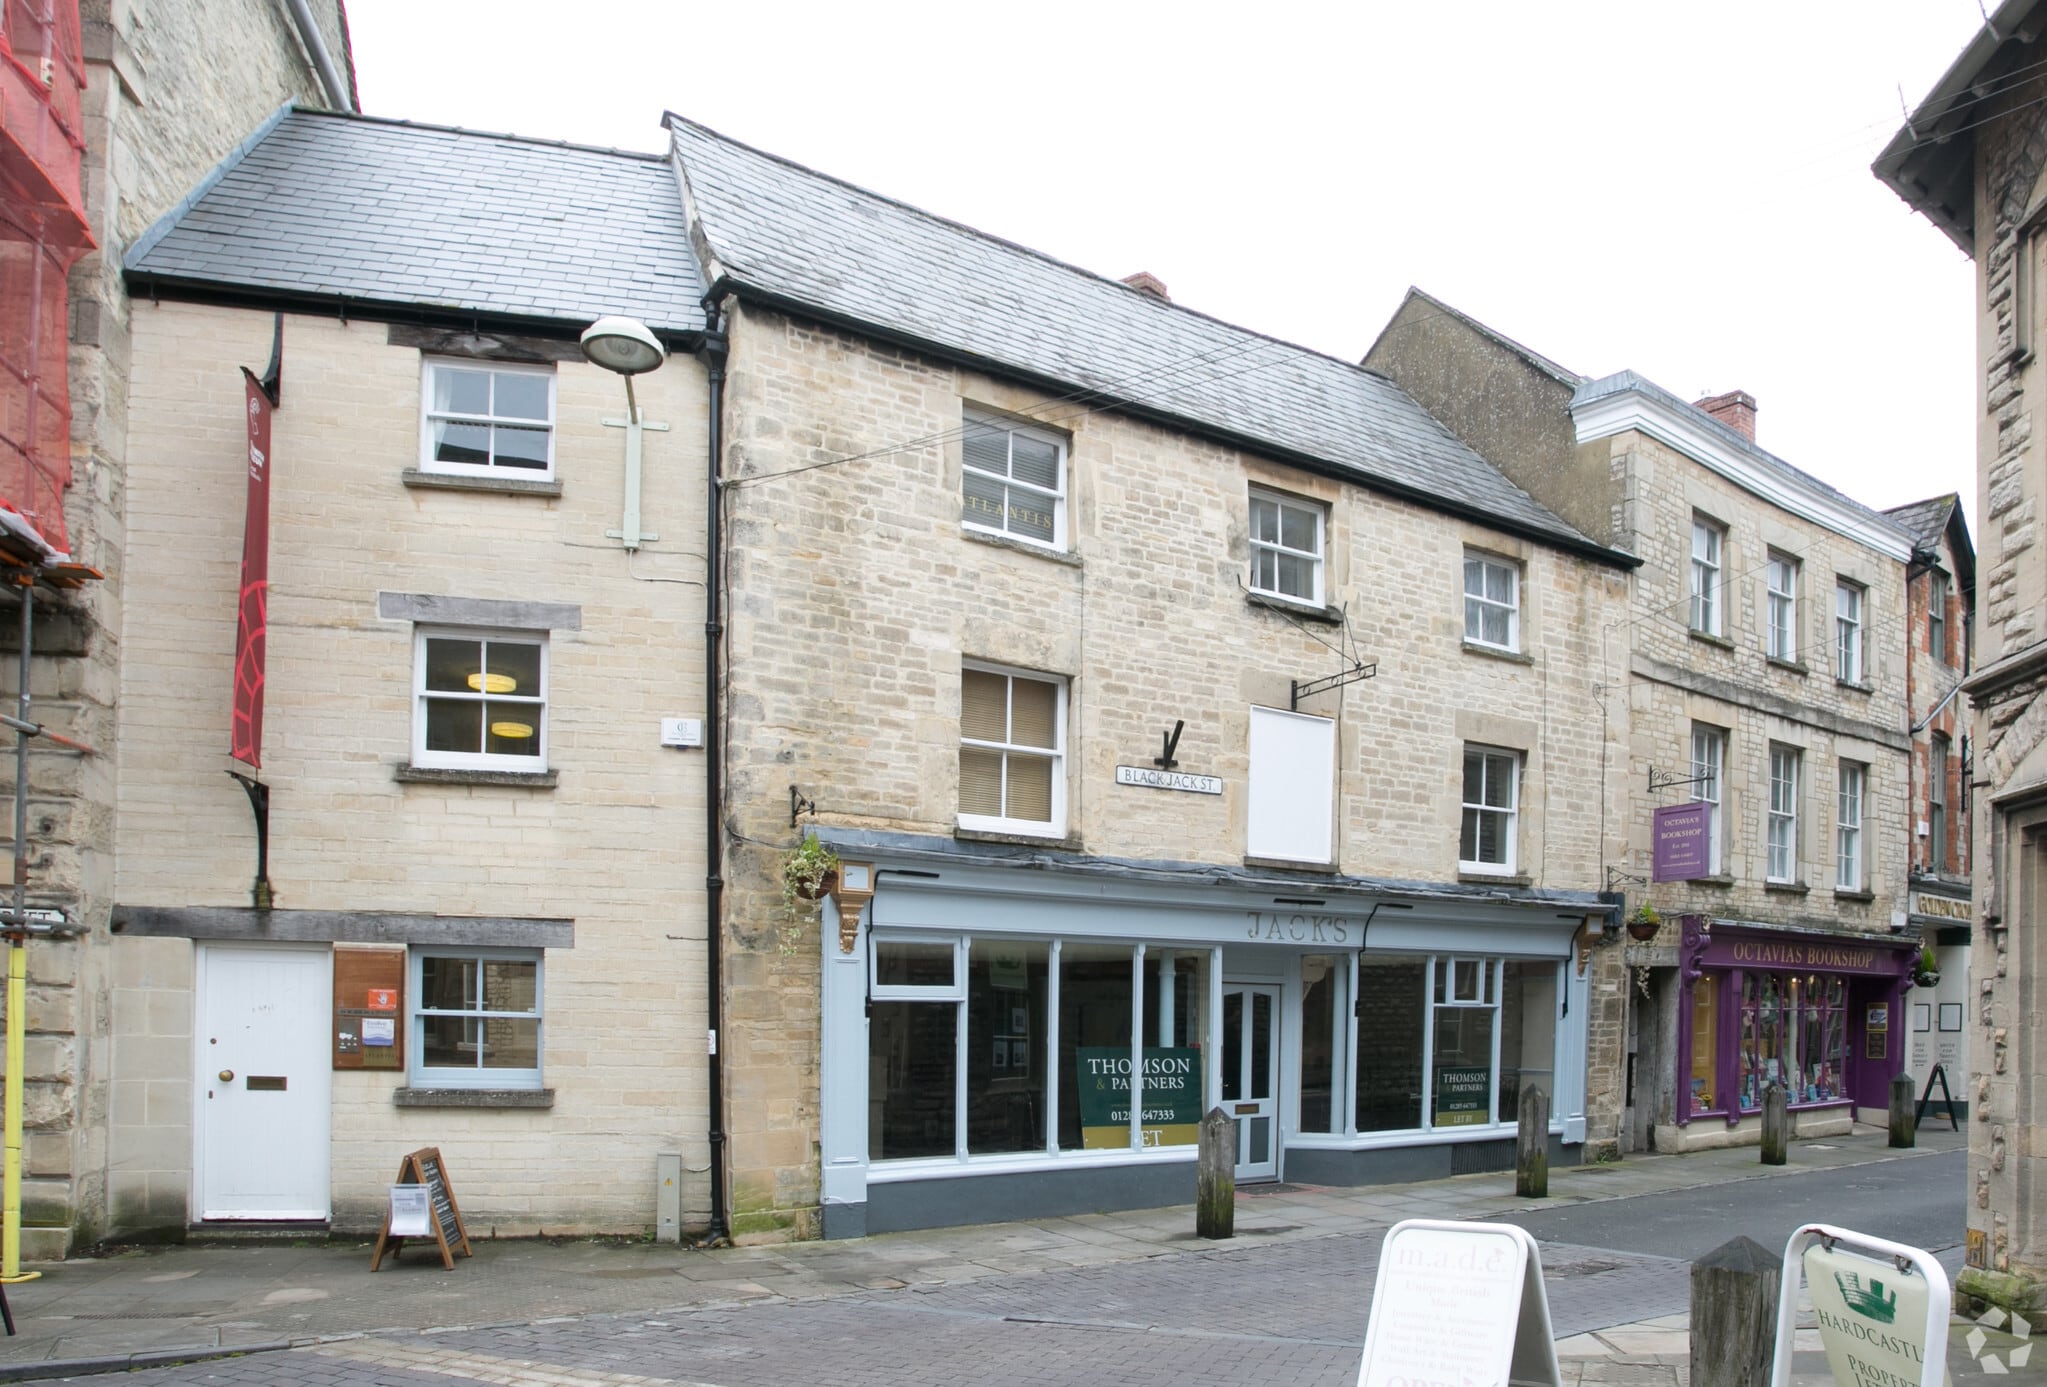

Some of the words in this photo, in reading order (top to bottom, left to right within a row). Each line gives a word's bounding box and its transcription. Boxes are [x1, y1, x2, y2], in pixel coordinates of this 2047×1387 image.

[1125, 769, 1164, 785] BLACK
[1166, 772, 1198, 790] JACK
[1200, 778, 1216, 791] ST.
[1661, 828, 1702, 839] BOOKSHOP
[1247, 911, 1347, 943] JACK'S
[1807, 947, 1873, 968] BOOKSHOP
[1096, 1077, 1105, 1089] &
[1112, 1077, 1184, 1089] PATNERS
[1443, 1072, 1487, 1083] THOMSON
[1452, 1083, 1483, 1092] PARTNERS
[1128, 1129, 1163, 1147] ET
[1818, 1309, 1923, 1363] HARDCASTL
